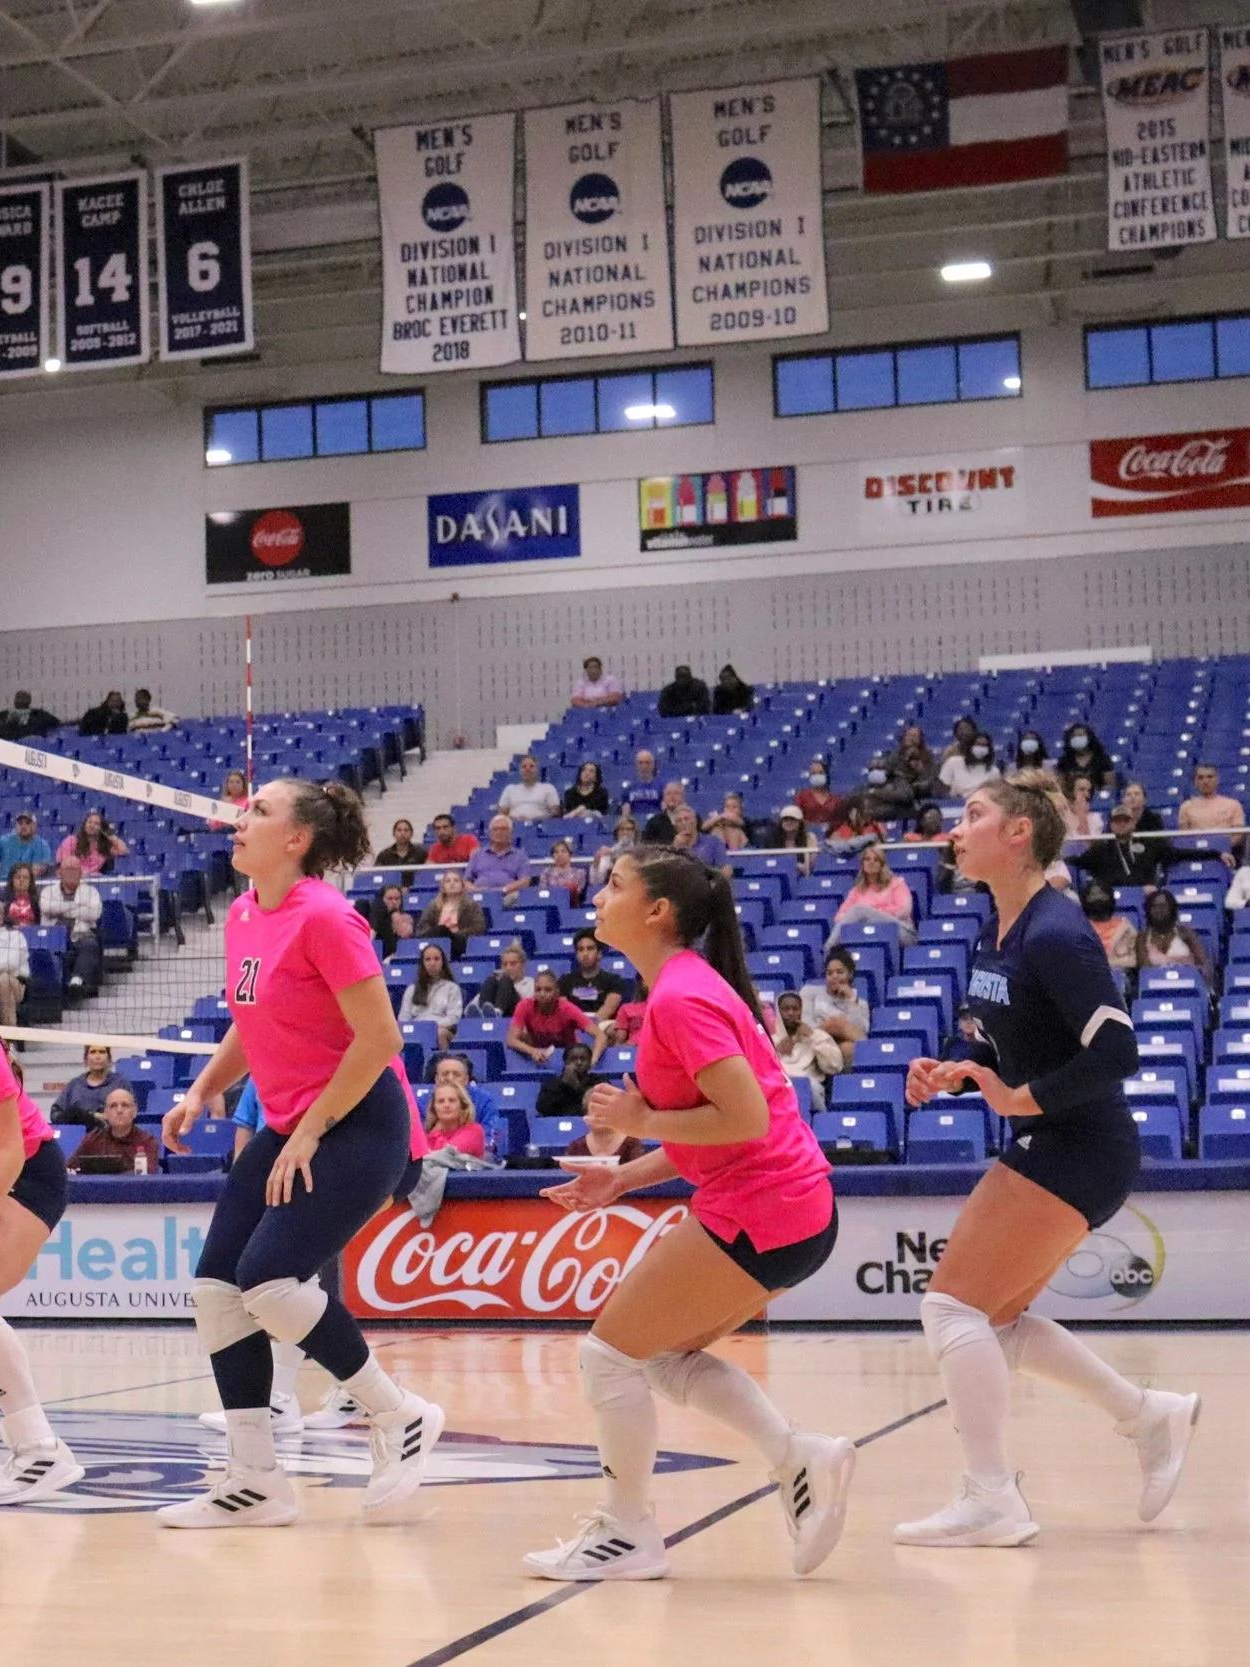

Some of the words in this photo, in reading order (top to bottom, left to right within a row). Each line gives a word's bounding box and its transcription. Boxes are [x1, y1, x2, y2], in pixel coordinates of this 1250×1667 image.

[1164, 34, 1203, 57] GOLF
[714, 96, 775, 118] MEN'S
[565, 113, 622, 136] MEN'S
[717, 125, 771, 148] GOLF
[1137, 119, 1176, 140] 2015
[416, 125, 473, 151] MEN'S
[425, 153, 465, 177] GOLF
[569, 143, 619, 164] GOLF
[1123, 169, 1196, 192] ATHLETIC
[179, 198, 226, 216] ALLEN
[1114, 192, 1208, 219] CONFERENCE
[82, 212, 121, 228] CAMP
[695, 219, 782, 245] DIVISION
[798, 217, 805, 235] I
[1120, 220, 1205, 245] CHAMPIONS
[401, 237, 479, 262] DIVISION
[545, 235, 627, 260] DIVISION
[642, 234, 649, 251] I
[187, 242, 220, 292] 6
[699, 249, 801, 274] NATIONAL
[73, 254, 133, 307] 14
[408, 262, 489, 288] NATIONAL
[549, 265, 645, 288] NATIONAL
[406, 286, 494, 313] CHAMPION
[693, 277, 811, 303] CHAMPIONS
[171, 306, 241, 325] VOLLEYBALL
[543, 292, 655, 318] CHAMPIONS
[393, 319, 432, 341] BROC
[440, 310, 507, 336] EVERETT
[710, 308, 797, 331] 2009-10
[561, 323, 636, 345] 2010-11
[432, 343, 470, 363] 2018
[1118, 437, 1234, 481] Coca-Cola
[436, 505, 567, 546] DASANI
[235, 957, 261, 1004] 21
[25, 1216, 208, 1281] Healt
[1110, 1266, 1154, 1285] abc
[26, 1291, 121, 1308] AUGUSTA
